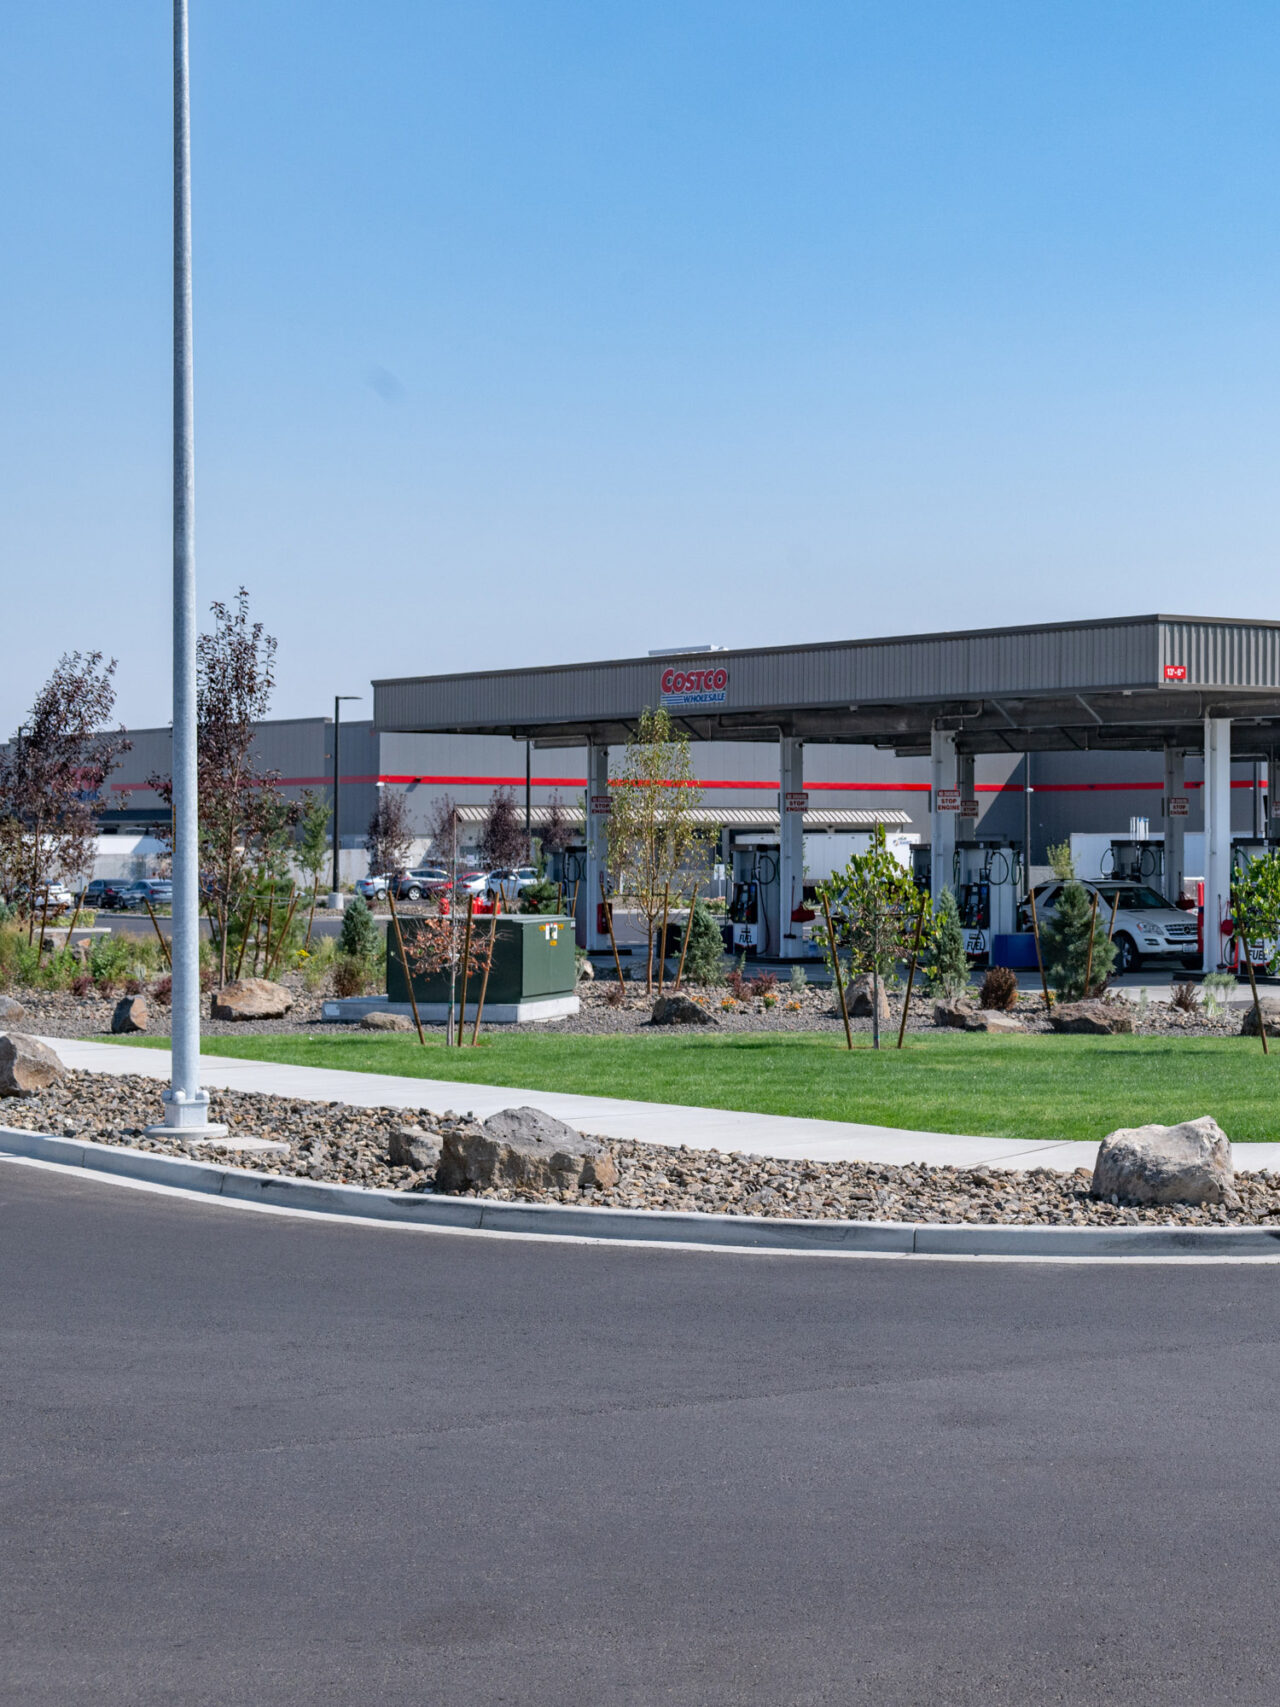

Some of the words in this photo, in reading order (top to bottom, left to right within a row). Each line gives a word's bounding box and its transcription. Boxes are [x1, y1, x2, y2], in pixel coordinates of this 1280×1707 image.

[661, 668, 727, 693] COSTCO
[683, 693, 726, 703] WHOLESALE
[966, 941, 984, 950] FUEL
[1248, 950, 1267, 960] FUEL
